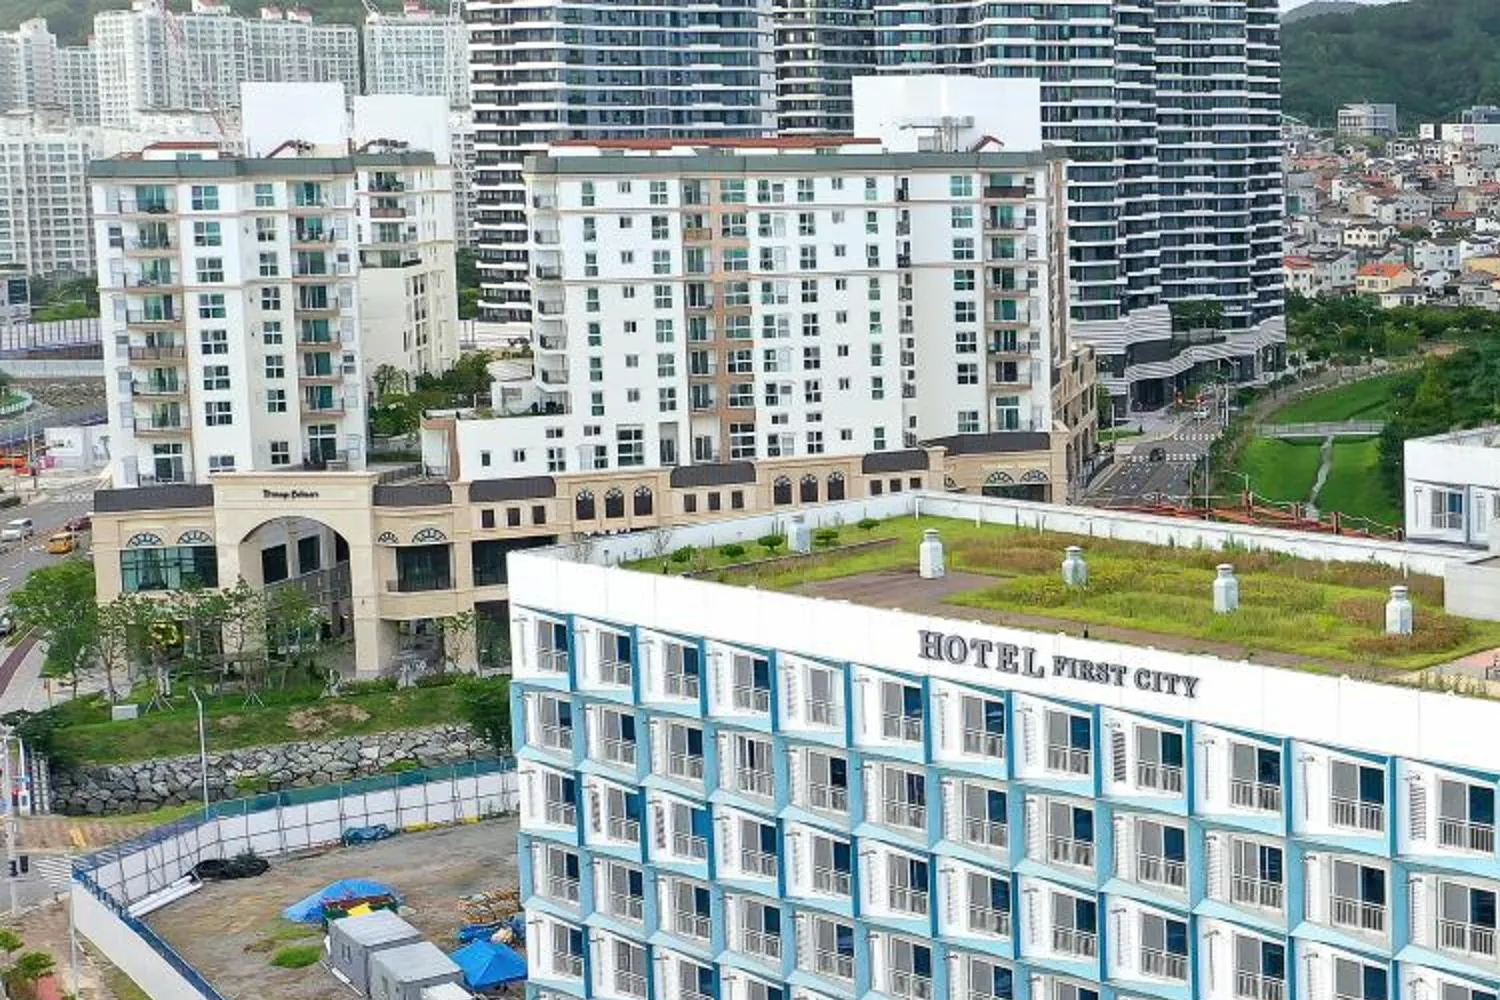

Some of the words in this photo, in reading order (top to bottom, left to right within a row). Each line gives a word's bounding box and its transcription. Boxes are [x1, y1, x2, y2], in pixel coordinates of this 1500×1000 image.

[918, 629, 1045, 678] HOTEL
[1052, 655, 1128, 687] FIRST
[1133, 667, 1200, 698] CITY
